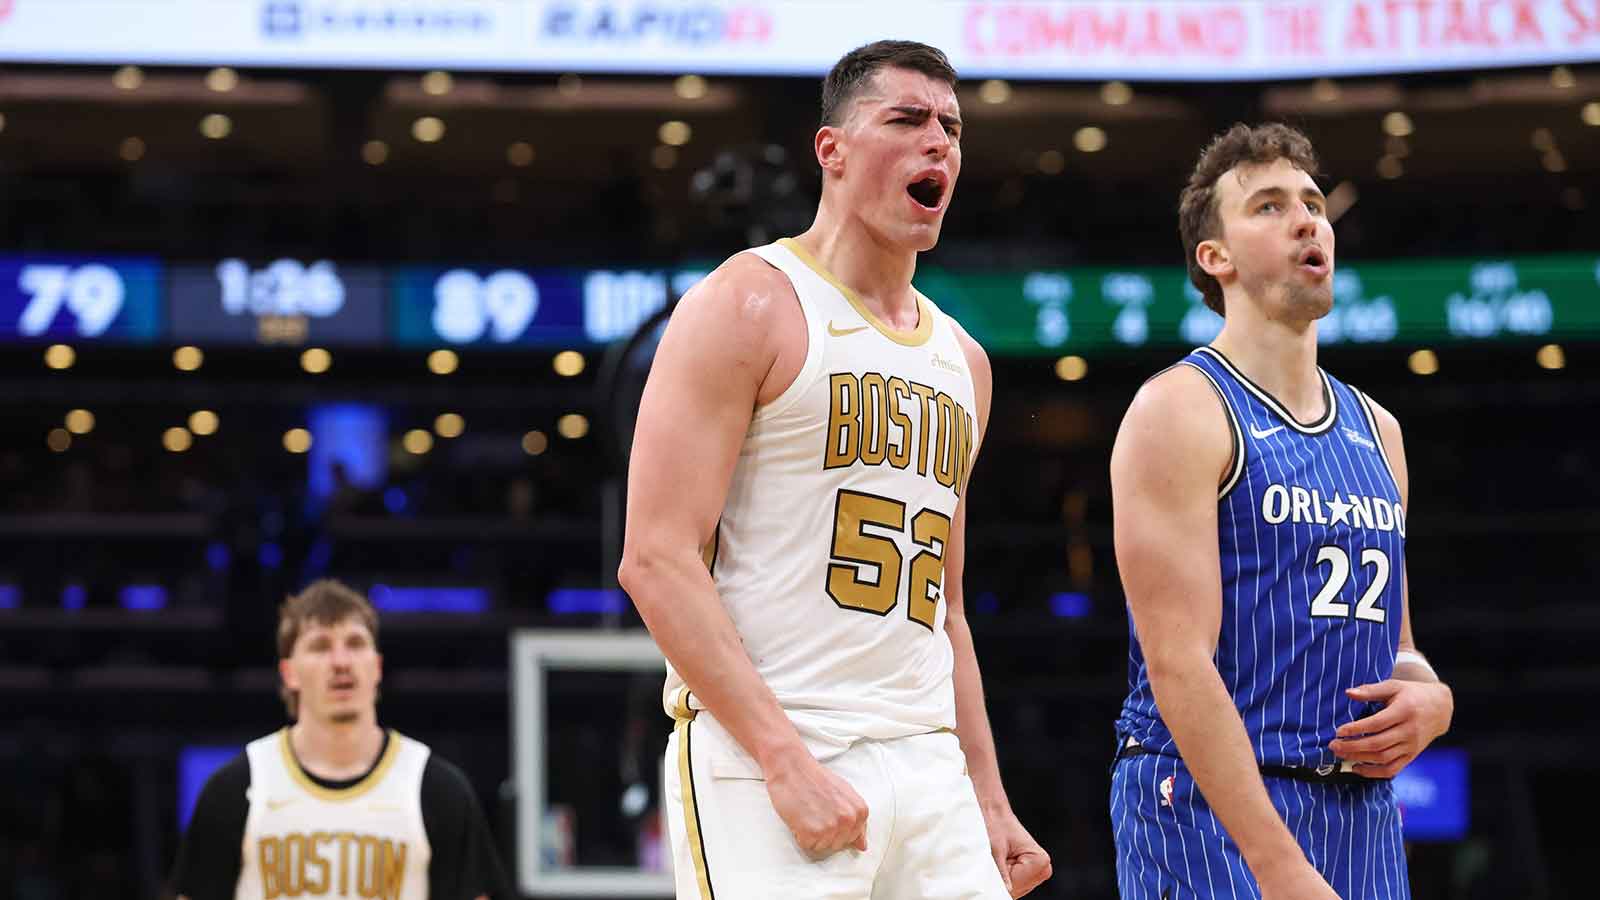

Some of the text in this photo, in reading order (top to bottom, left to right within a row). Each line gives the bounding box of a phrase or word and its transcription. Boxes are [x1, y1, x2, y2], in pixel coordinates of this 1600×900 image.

[19, 263, 124, 337] 79
[433, 268, 539, 342] 89
[823, 372, 972, 498] BOSTON
[825, 487, 951, 633] 52
[1310, 545, 1390, 624] 22
[257, 830, 408, 900] BOSTON
